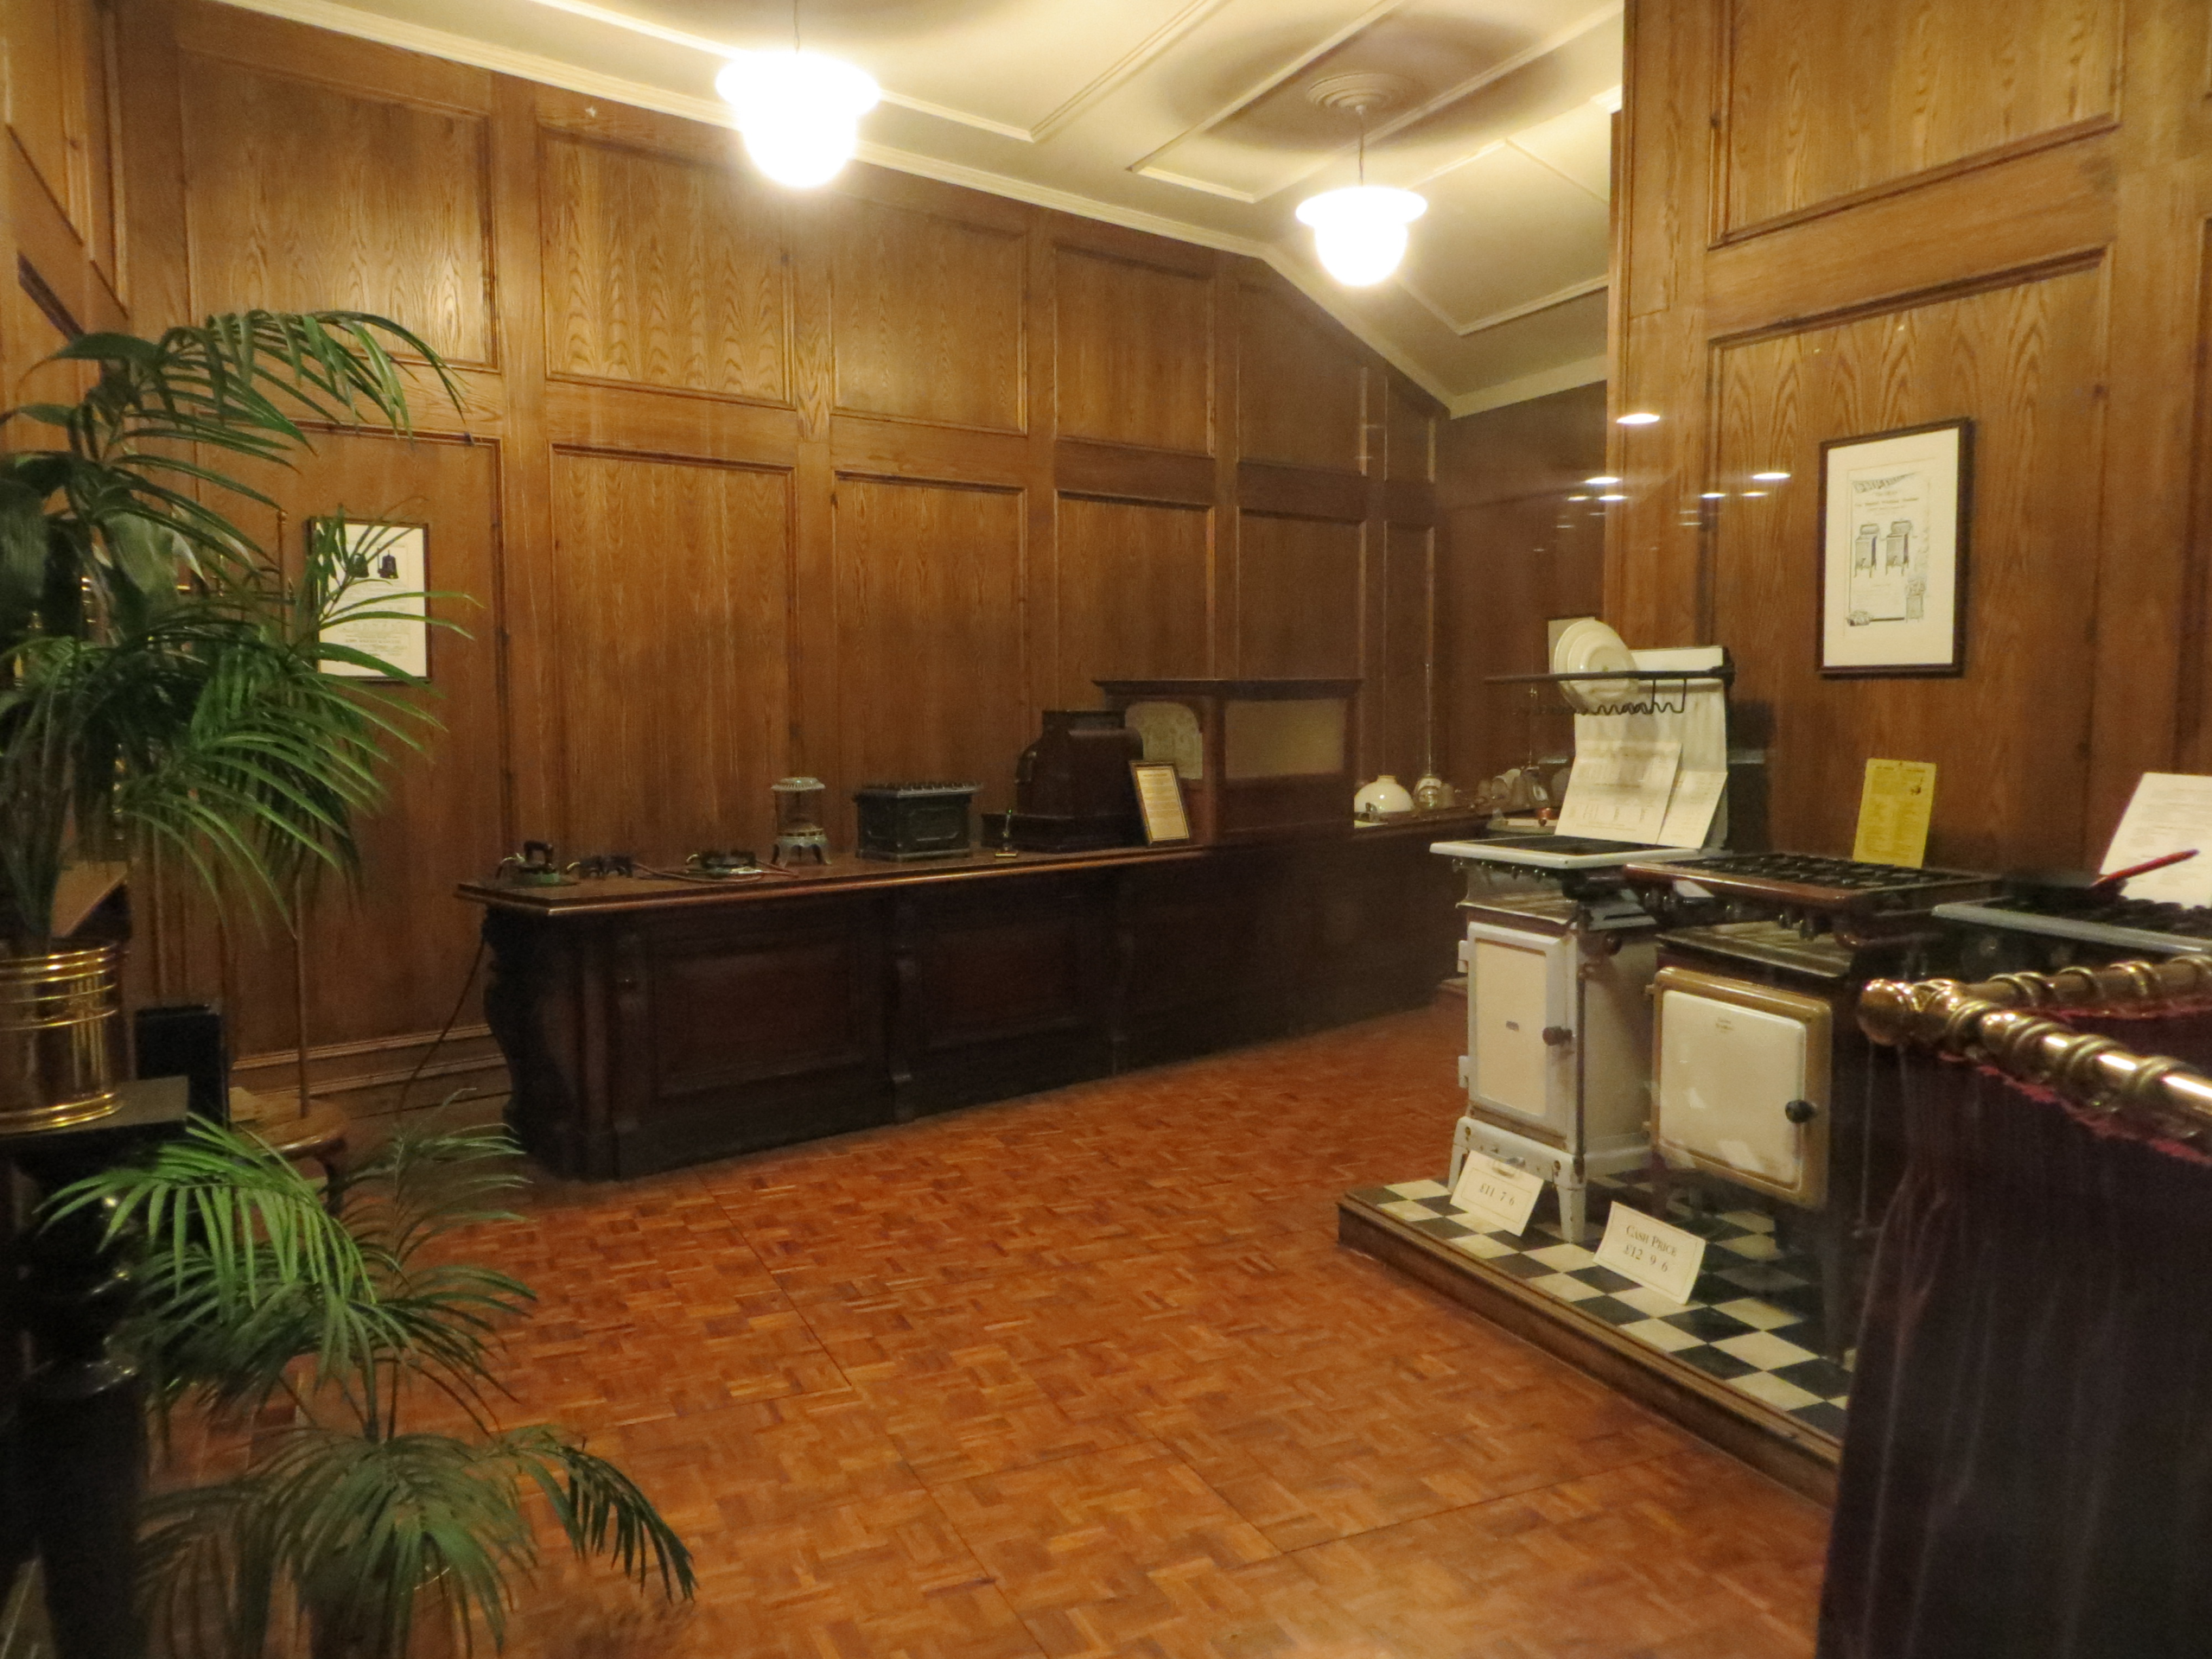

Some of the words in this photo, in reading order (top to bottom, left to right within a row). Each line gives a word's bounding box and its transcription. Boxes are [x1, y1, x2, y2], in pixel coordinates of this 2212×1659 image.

[1499, 1191, 1507, 1202] 7
[1509, 1196, 1516, 1206] 6
[1623, 1244, 1643, 1261] £12
[1649, 1254, 1657, 1265] 9
[1661, 1262, 1669, 1273] 6
